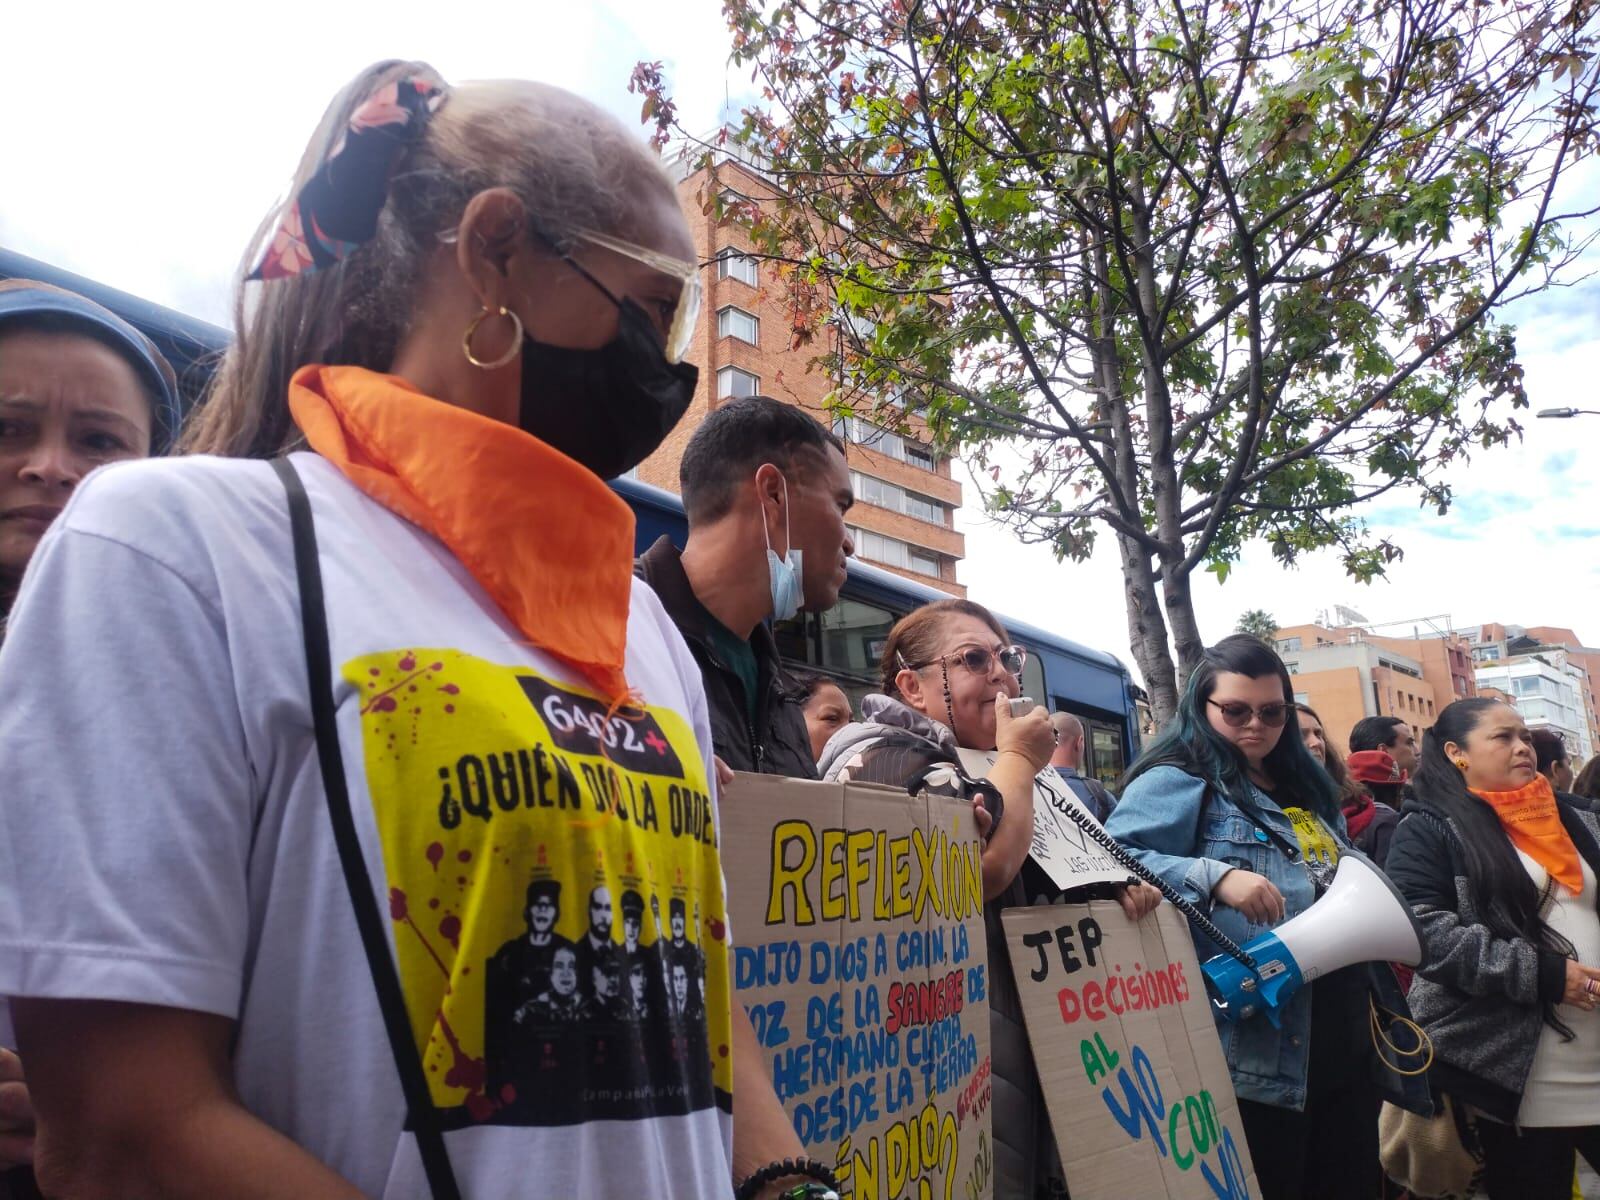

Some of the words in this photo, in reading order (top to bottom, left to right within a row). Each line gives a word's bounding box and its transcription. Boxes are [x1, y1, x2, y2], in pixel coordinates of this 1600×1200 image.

[438, 742, 582, 830] ¿QUIÉN
[625, 775, 659, 833] LA
[668, 783, 718, 849] ORDE
[735, 939, 800, 990] DIJO
[808, 937, 868, 985] DIOS
[874, 932, 888, 977] A
[952, 923, 969, 964] LA
[1023, 917, 1102, 982] JEP
[743, 1001, 789, 1048] OZ
[807, 992, 843, 1041] DE
[854, 984, 880, 1028] LA
[886, 968, 964, 1036] SANGRE
[968, 964, 985, 1003] DE
[774, 1026, 900, 1102] HERMANO
[794, 1076, 880, 1147] DESDE
[886, 1068, 914, 1113] LA
[921, 1033, 977, 1101] TIERRA
[1080, 1031, 1120, 1085] AL
[1102, 1045, 1167, 1157] YO
